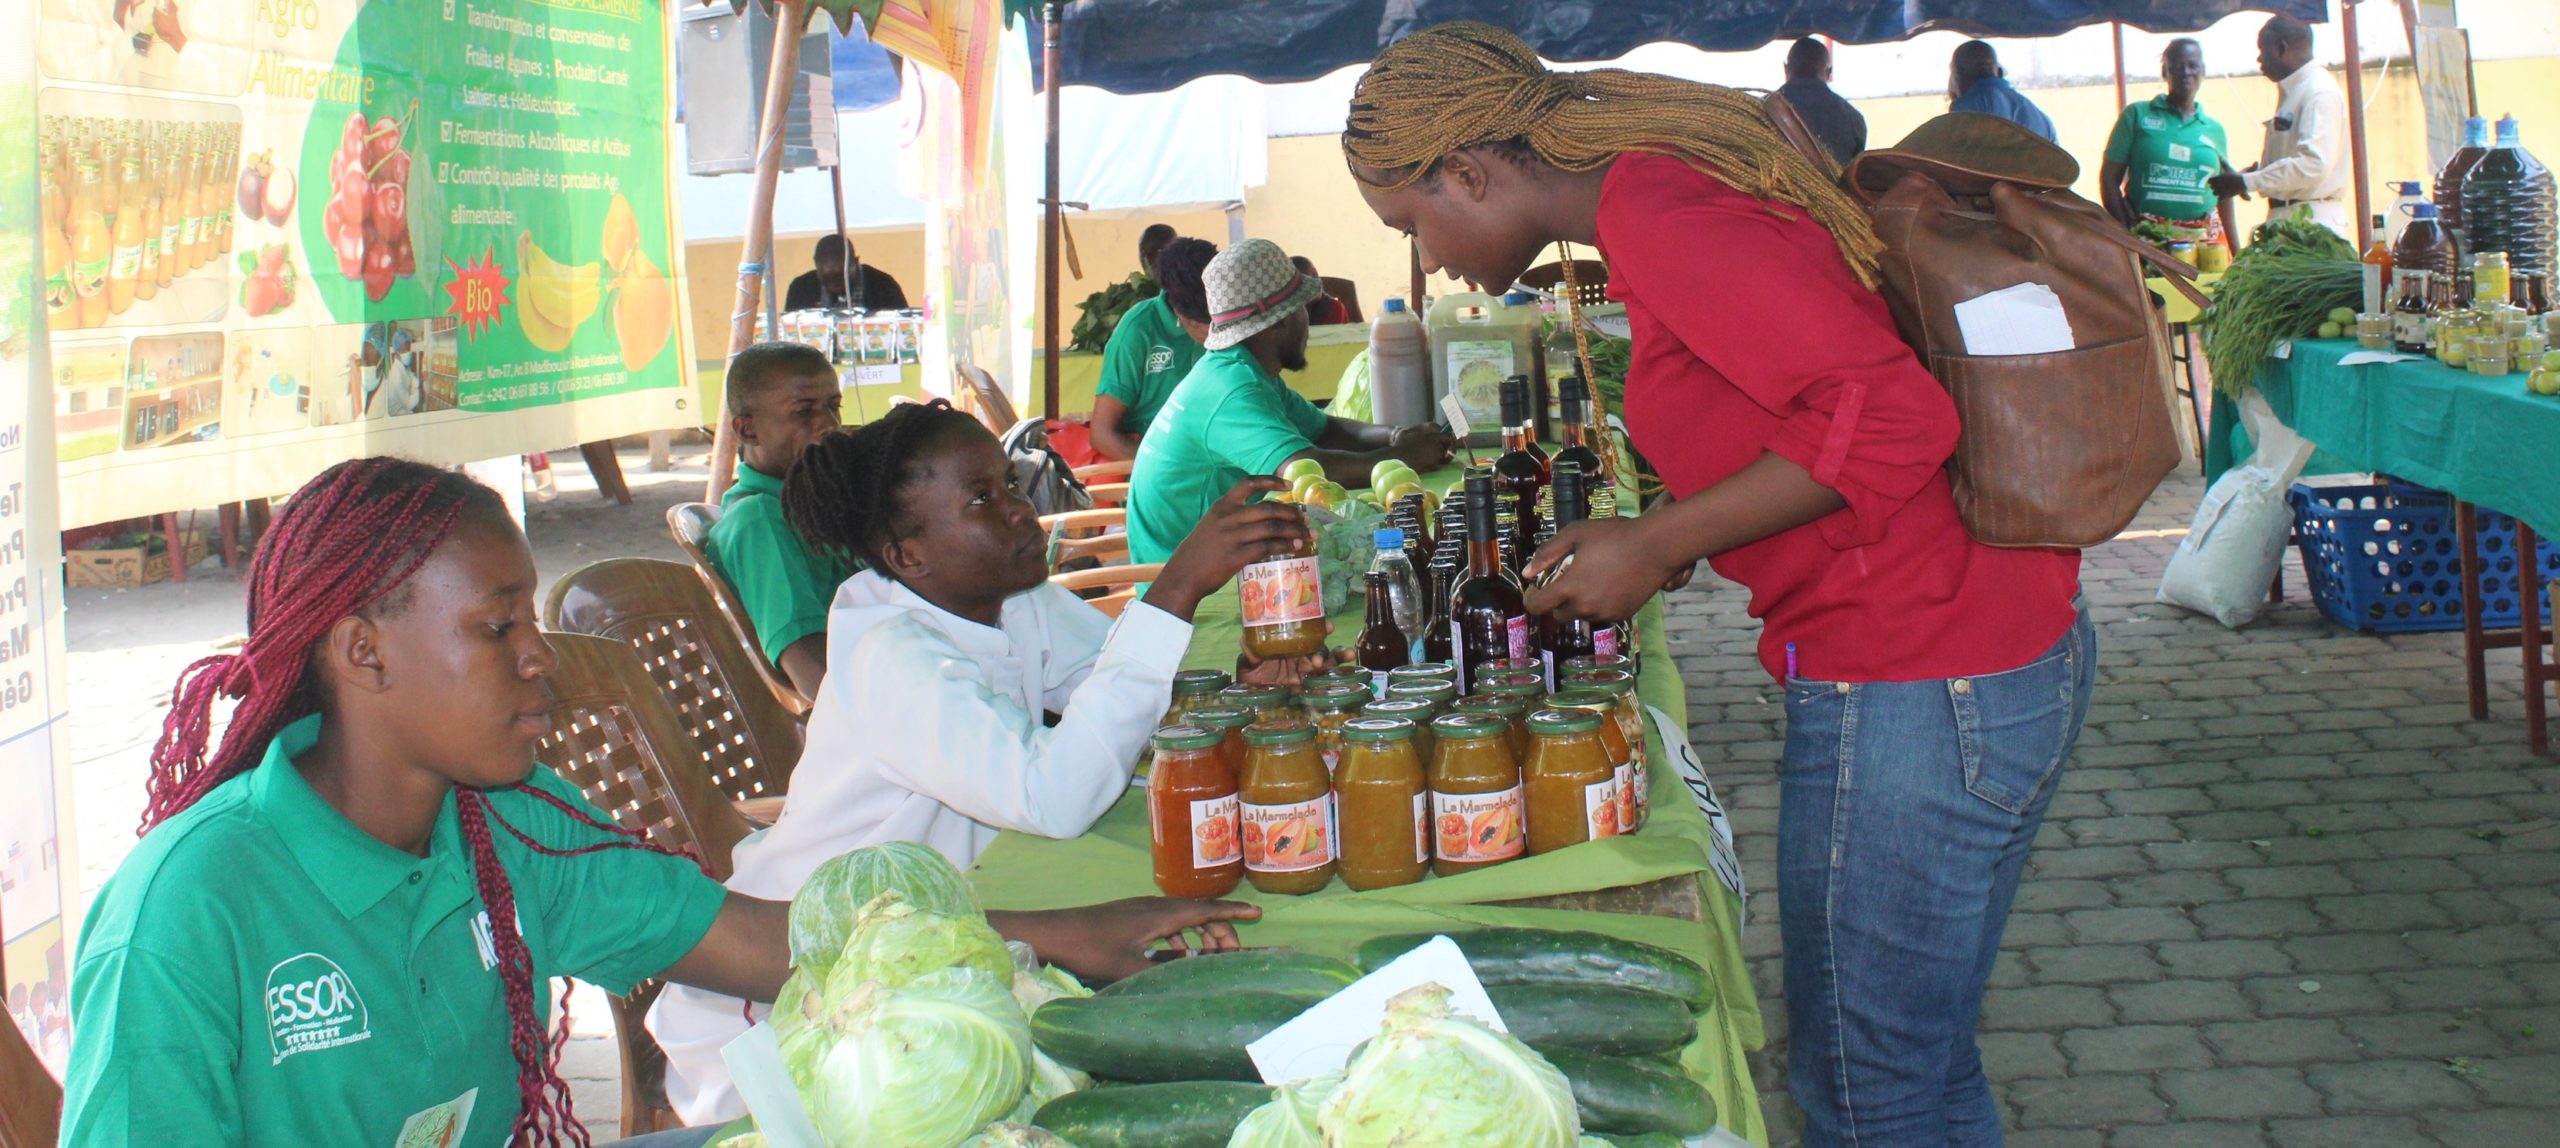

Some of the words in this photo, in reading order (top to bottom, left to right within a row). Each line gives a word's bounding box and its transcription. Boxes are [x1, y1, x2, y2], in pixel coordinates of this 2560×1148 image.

[535, 23, 546, 40] et
[549, 27, 616, 49] conservation
[465, 44, 493, 68] Fruits
[494, 53, 504, 70] et
[554, 58, 598, 82] Produits
[246, 50, 375, 105] Alimentaire
[498, 92, 510, 110] et
[454, 122, 526, 150] Fermentations
[451, 162, 501, 187] Contrôle
[502, 166, 541, 192] qualité
[560, 170, 602, 194] produits
[2198, 165, 2214, 188] 7
[466, 278, 492, 313] Bio
[1243, 569, 1254, 582] La
[1204, 803, 1220, 818] La
[1243, 806, 1255, 821] La
[1256, 804, 1317, 822] Marmelade
[1441, 798, 1457, 814] La
[1460, 793, 1517, 814] Marmelade
[268, 971, 355, 1027] ESSOR
